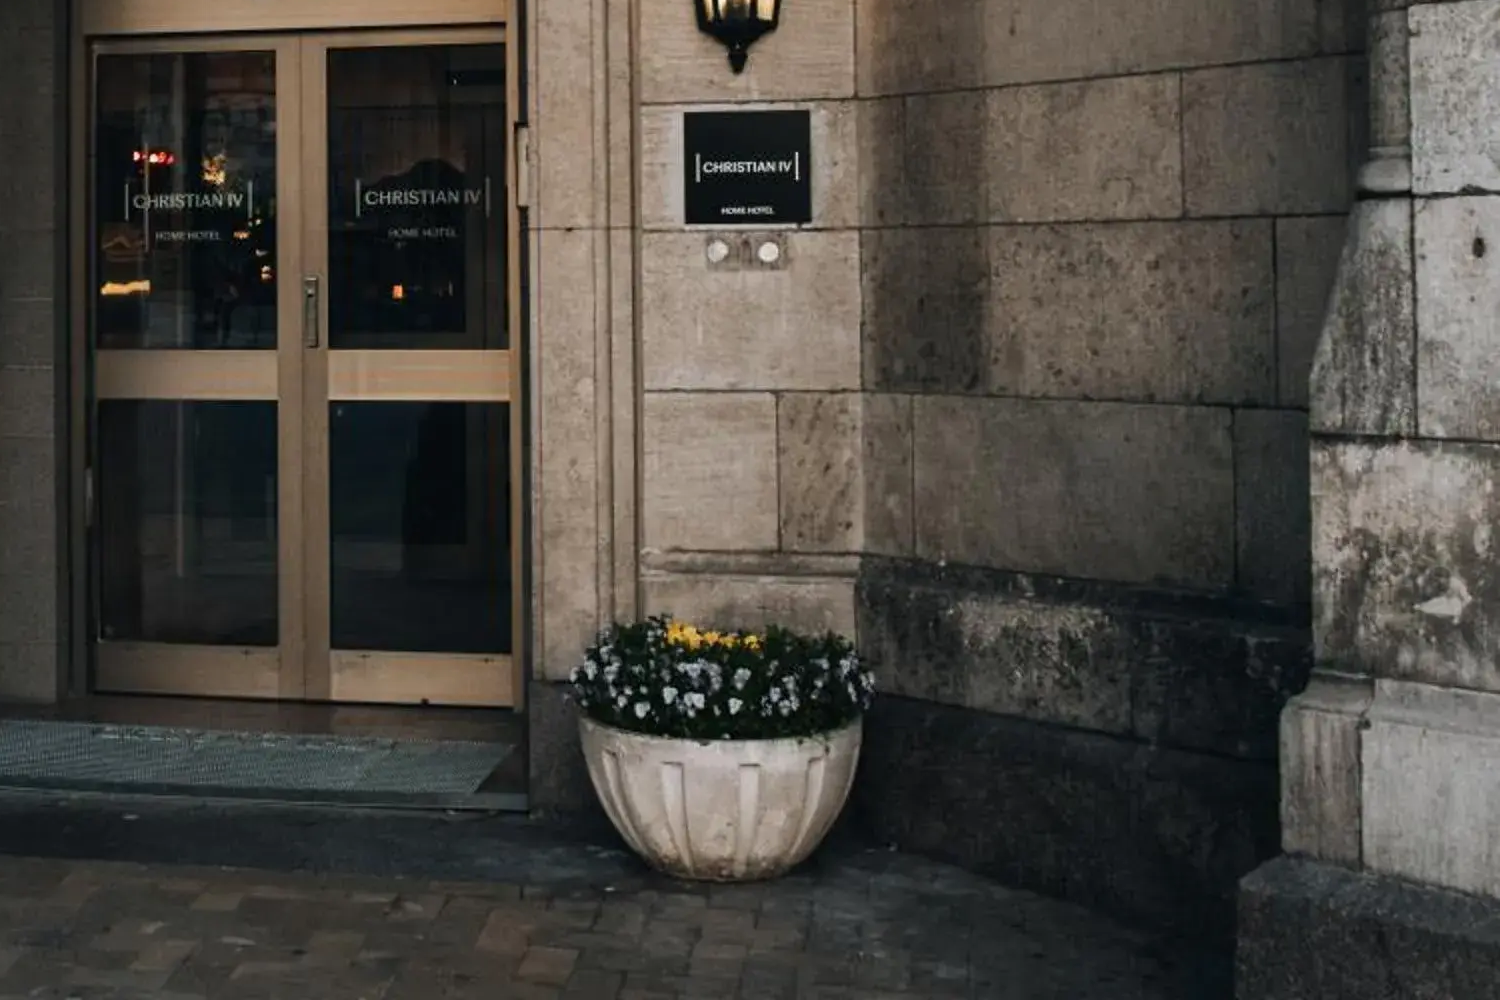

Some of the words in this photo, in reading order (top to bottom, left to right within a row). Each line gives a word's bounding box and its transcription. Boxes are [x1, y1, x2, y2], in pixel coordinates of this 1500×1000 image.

[702, 161, 775, 174] CHRISTIAN
[778, 161, 792, 173] IV
[133, 193, 224, 209] CHRISTIAN
[227, 192, 243, 208] IV
[365, 189, 459, 205] CHRISTIAN
[464, 189, 480, 204] IV
